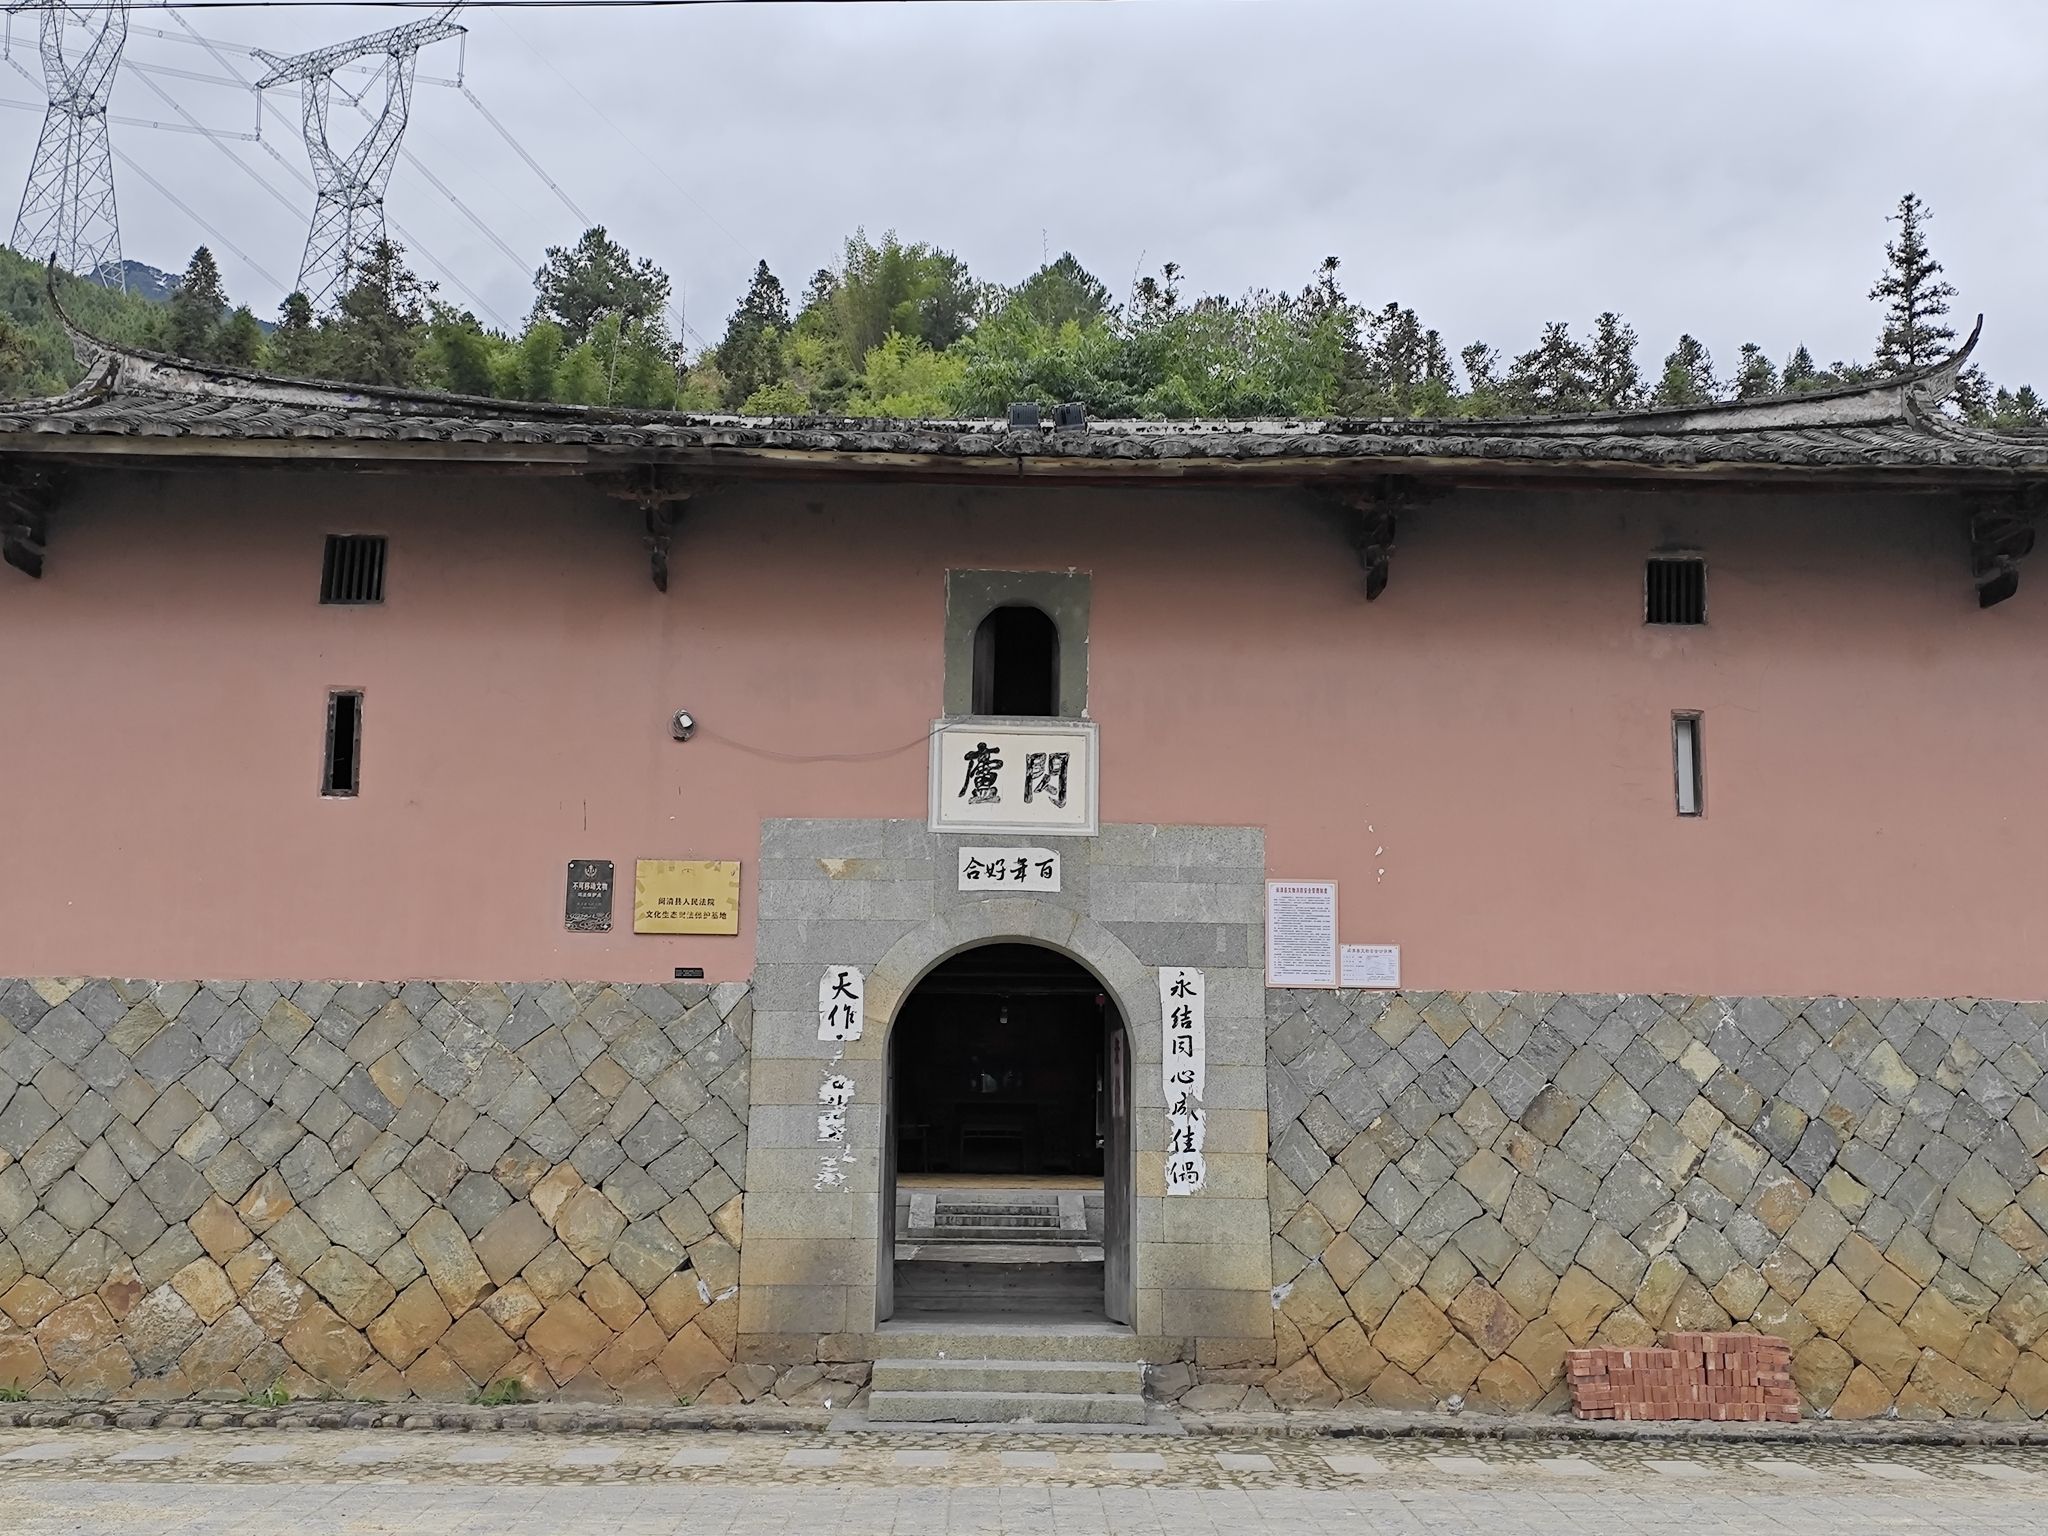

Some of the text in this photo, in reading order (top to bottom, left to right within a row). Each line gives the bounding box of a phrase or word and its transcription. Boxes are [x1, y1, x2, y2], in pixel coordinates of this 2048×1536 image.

[572, 882, 608, 891] 不可移动文物
[658, 897, 715, 906] 闽清县人民法院
